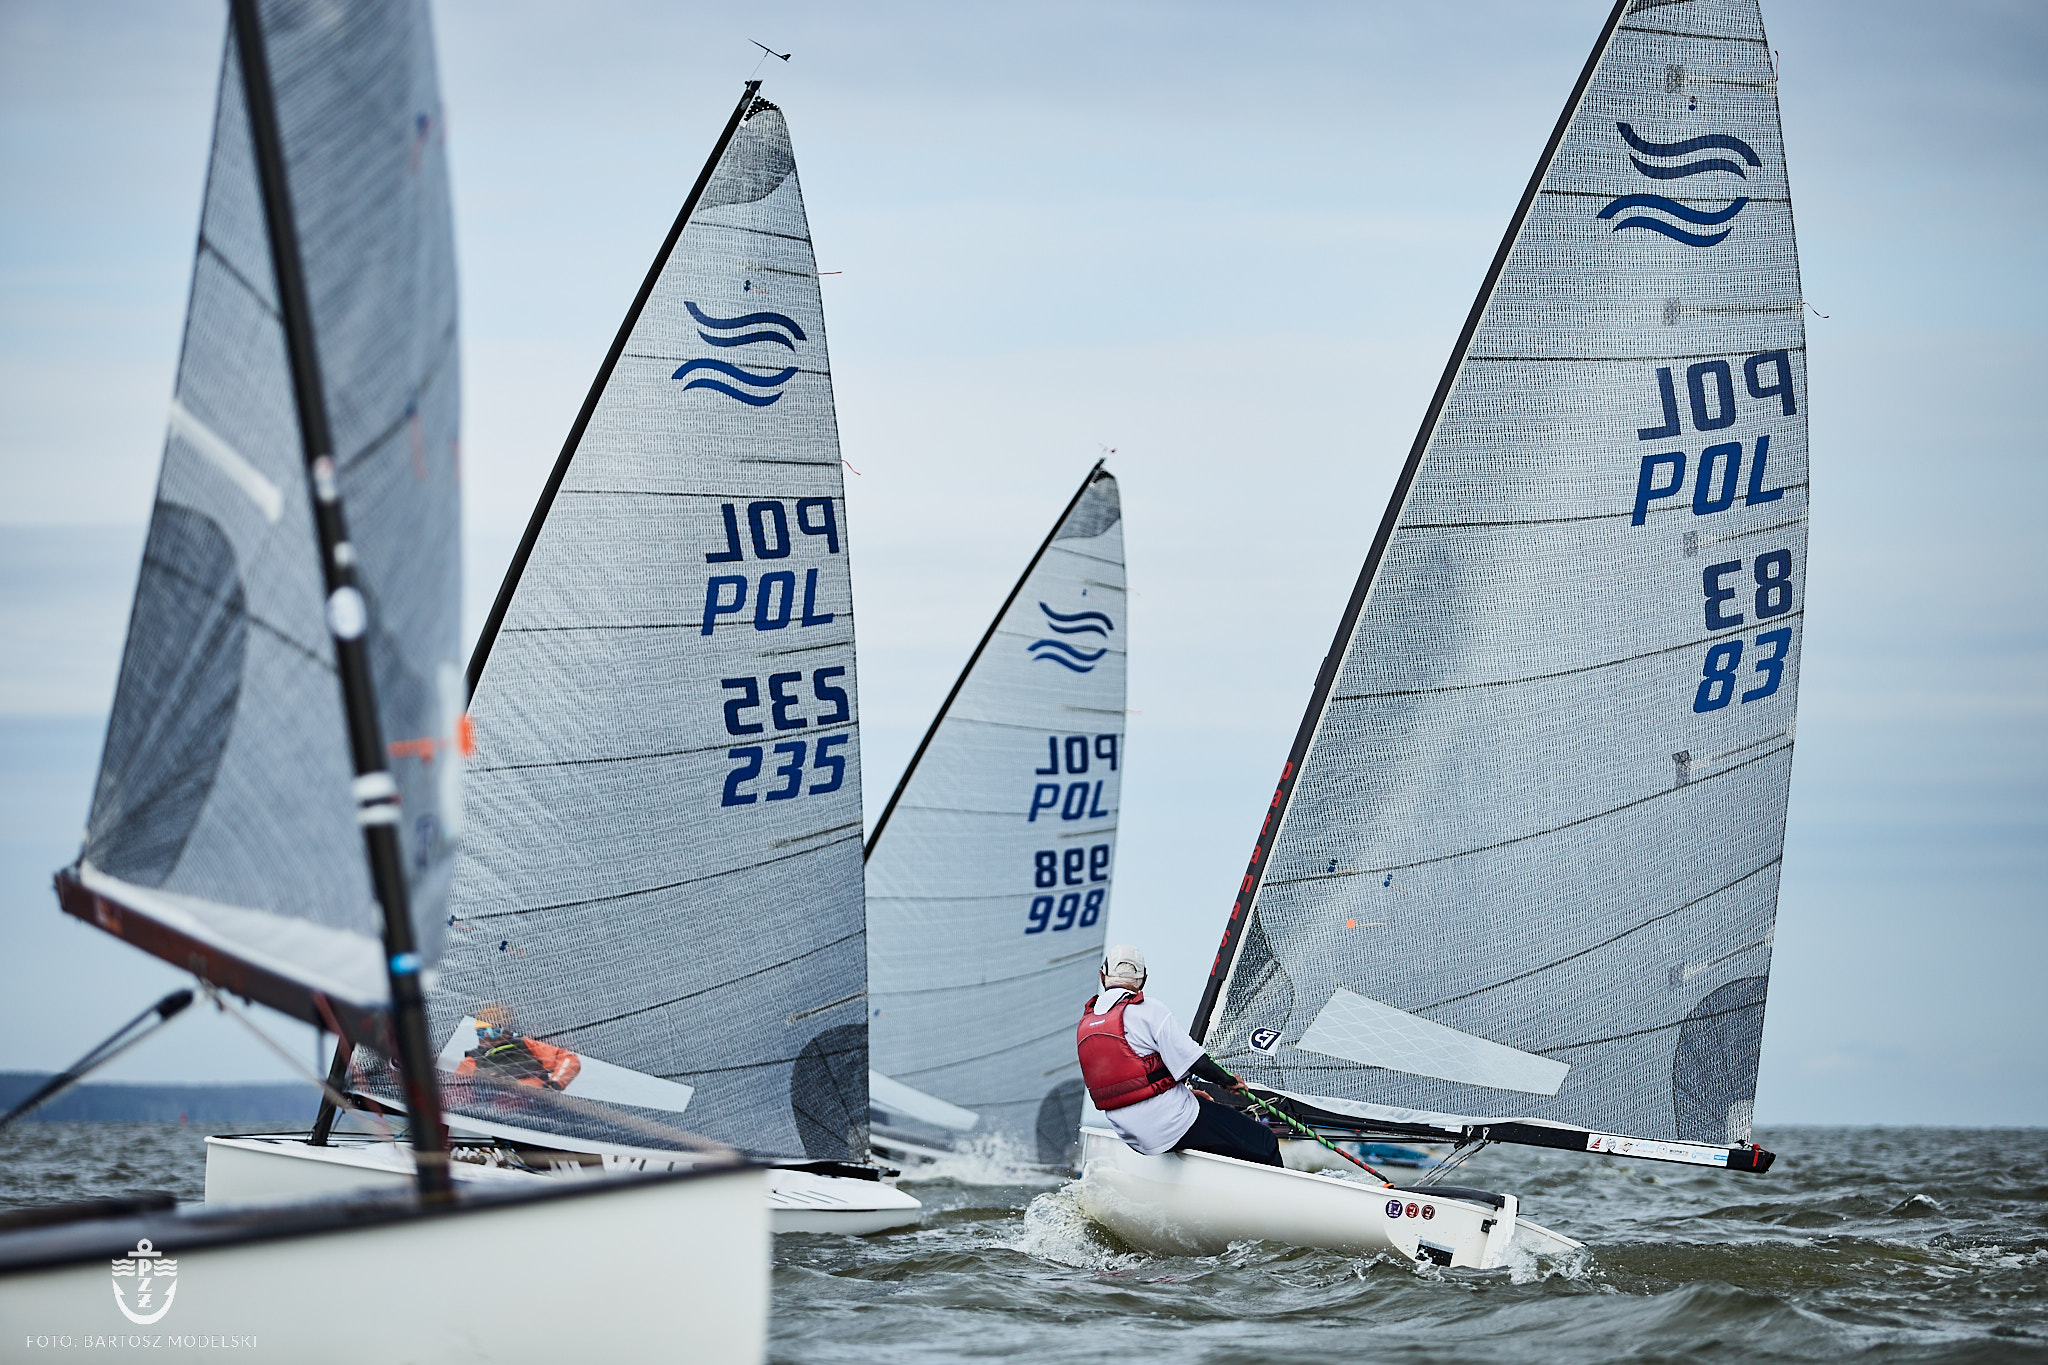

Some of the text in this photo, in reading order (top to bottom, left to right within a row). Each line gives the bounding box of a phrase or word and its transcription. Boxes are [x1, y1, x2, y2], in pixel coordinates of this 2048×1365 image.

[1631, 435, 1784, 526] POL
[701, 568, 834, 636] POL
[1693, 627, 1792, 713] 83
[721, 734, 849, 807] 235
[1027, 780, 1108, 822] POL
[1025, 888, 1105, 934] 998
